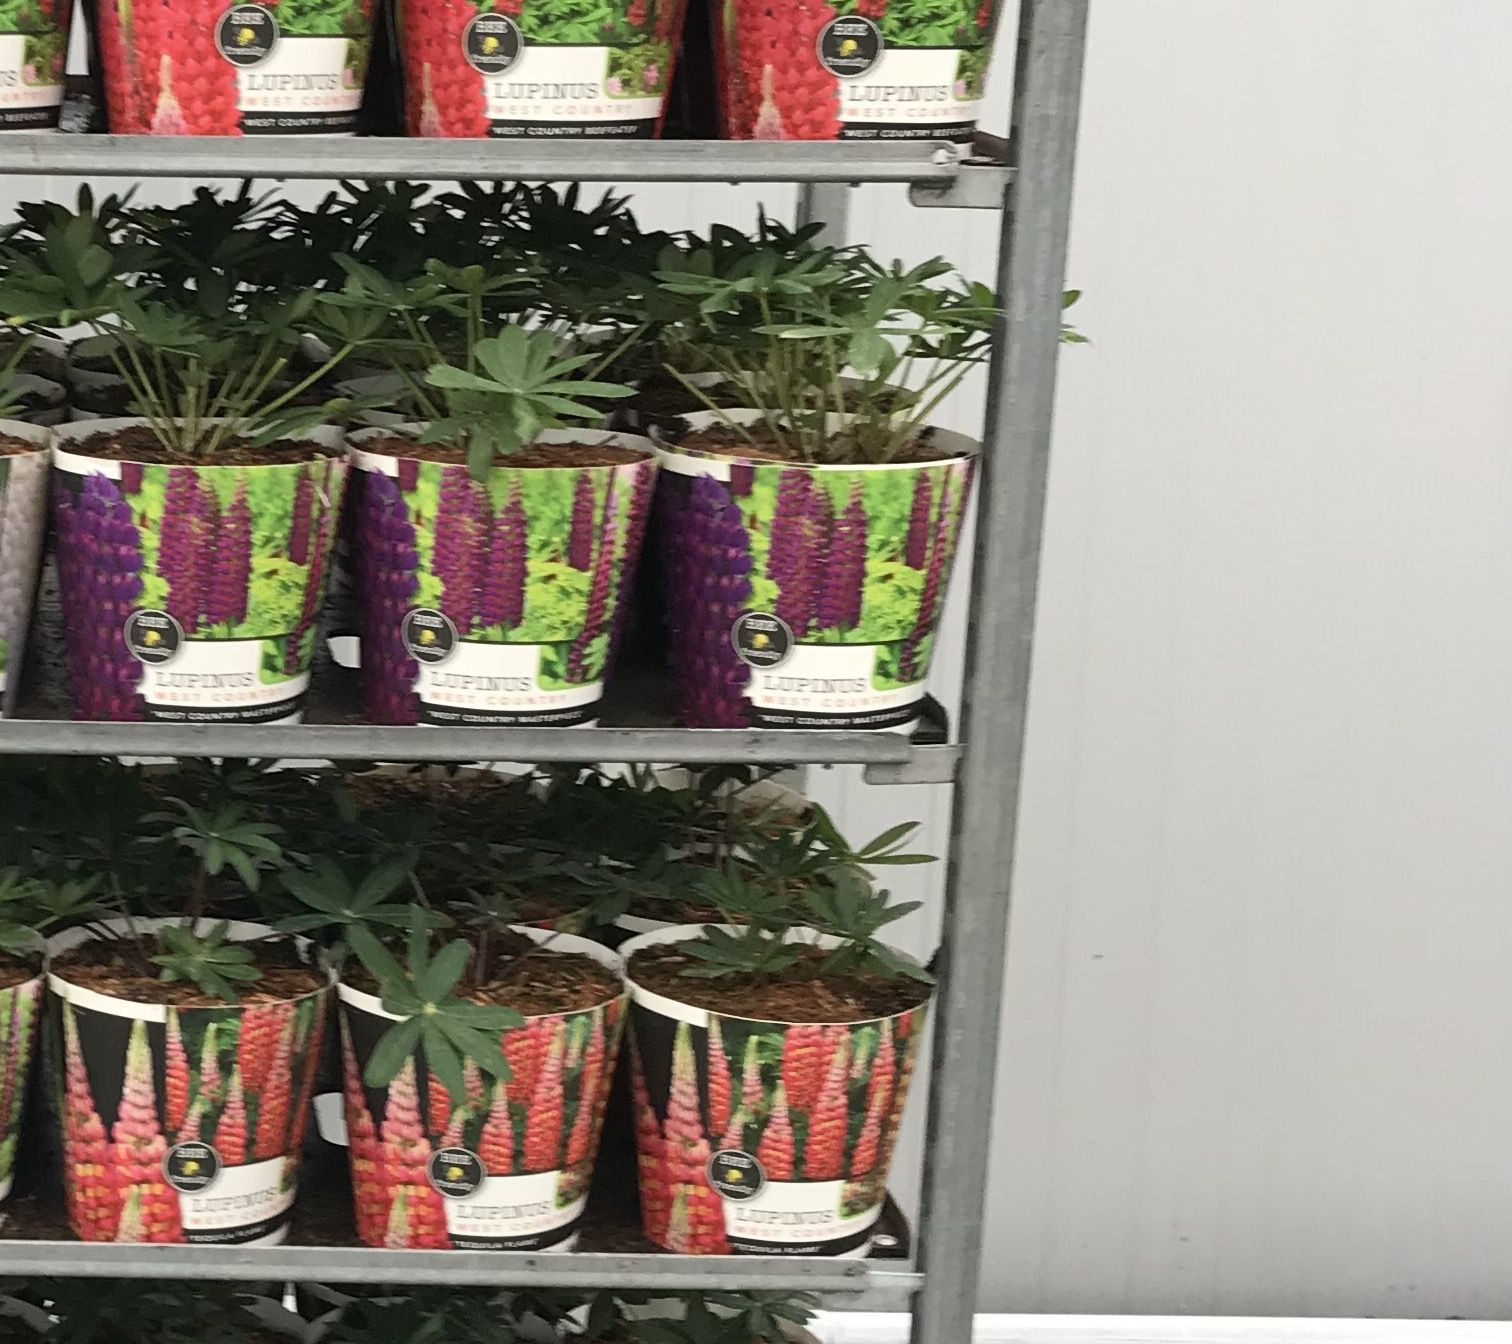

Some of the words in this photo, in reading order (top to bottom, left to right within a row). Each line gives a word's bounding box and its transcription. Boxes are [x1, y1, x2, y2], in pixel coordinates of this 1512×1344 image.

[247, 74, 339, 91] LUPINUS
[494, 83, 600, 99] LUPINUS
[849, 85, 949, 101] LUPINUS
[155, 671, 255, 688] LUPINUS
[430, 671, 532, 691] LUPINUS
[762, 675, 867, 693] LUPINUS
